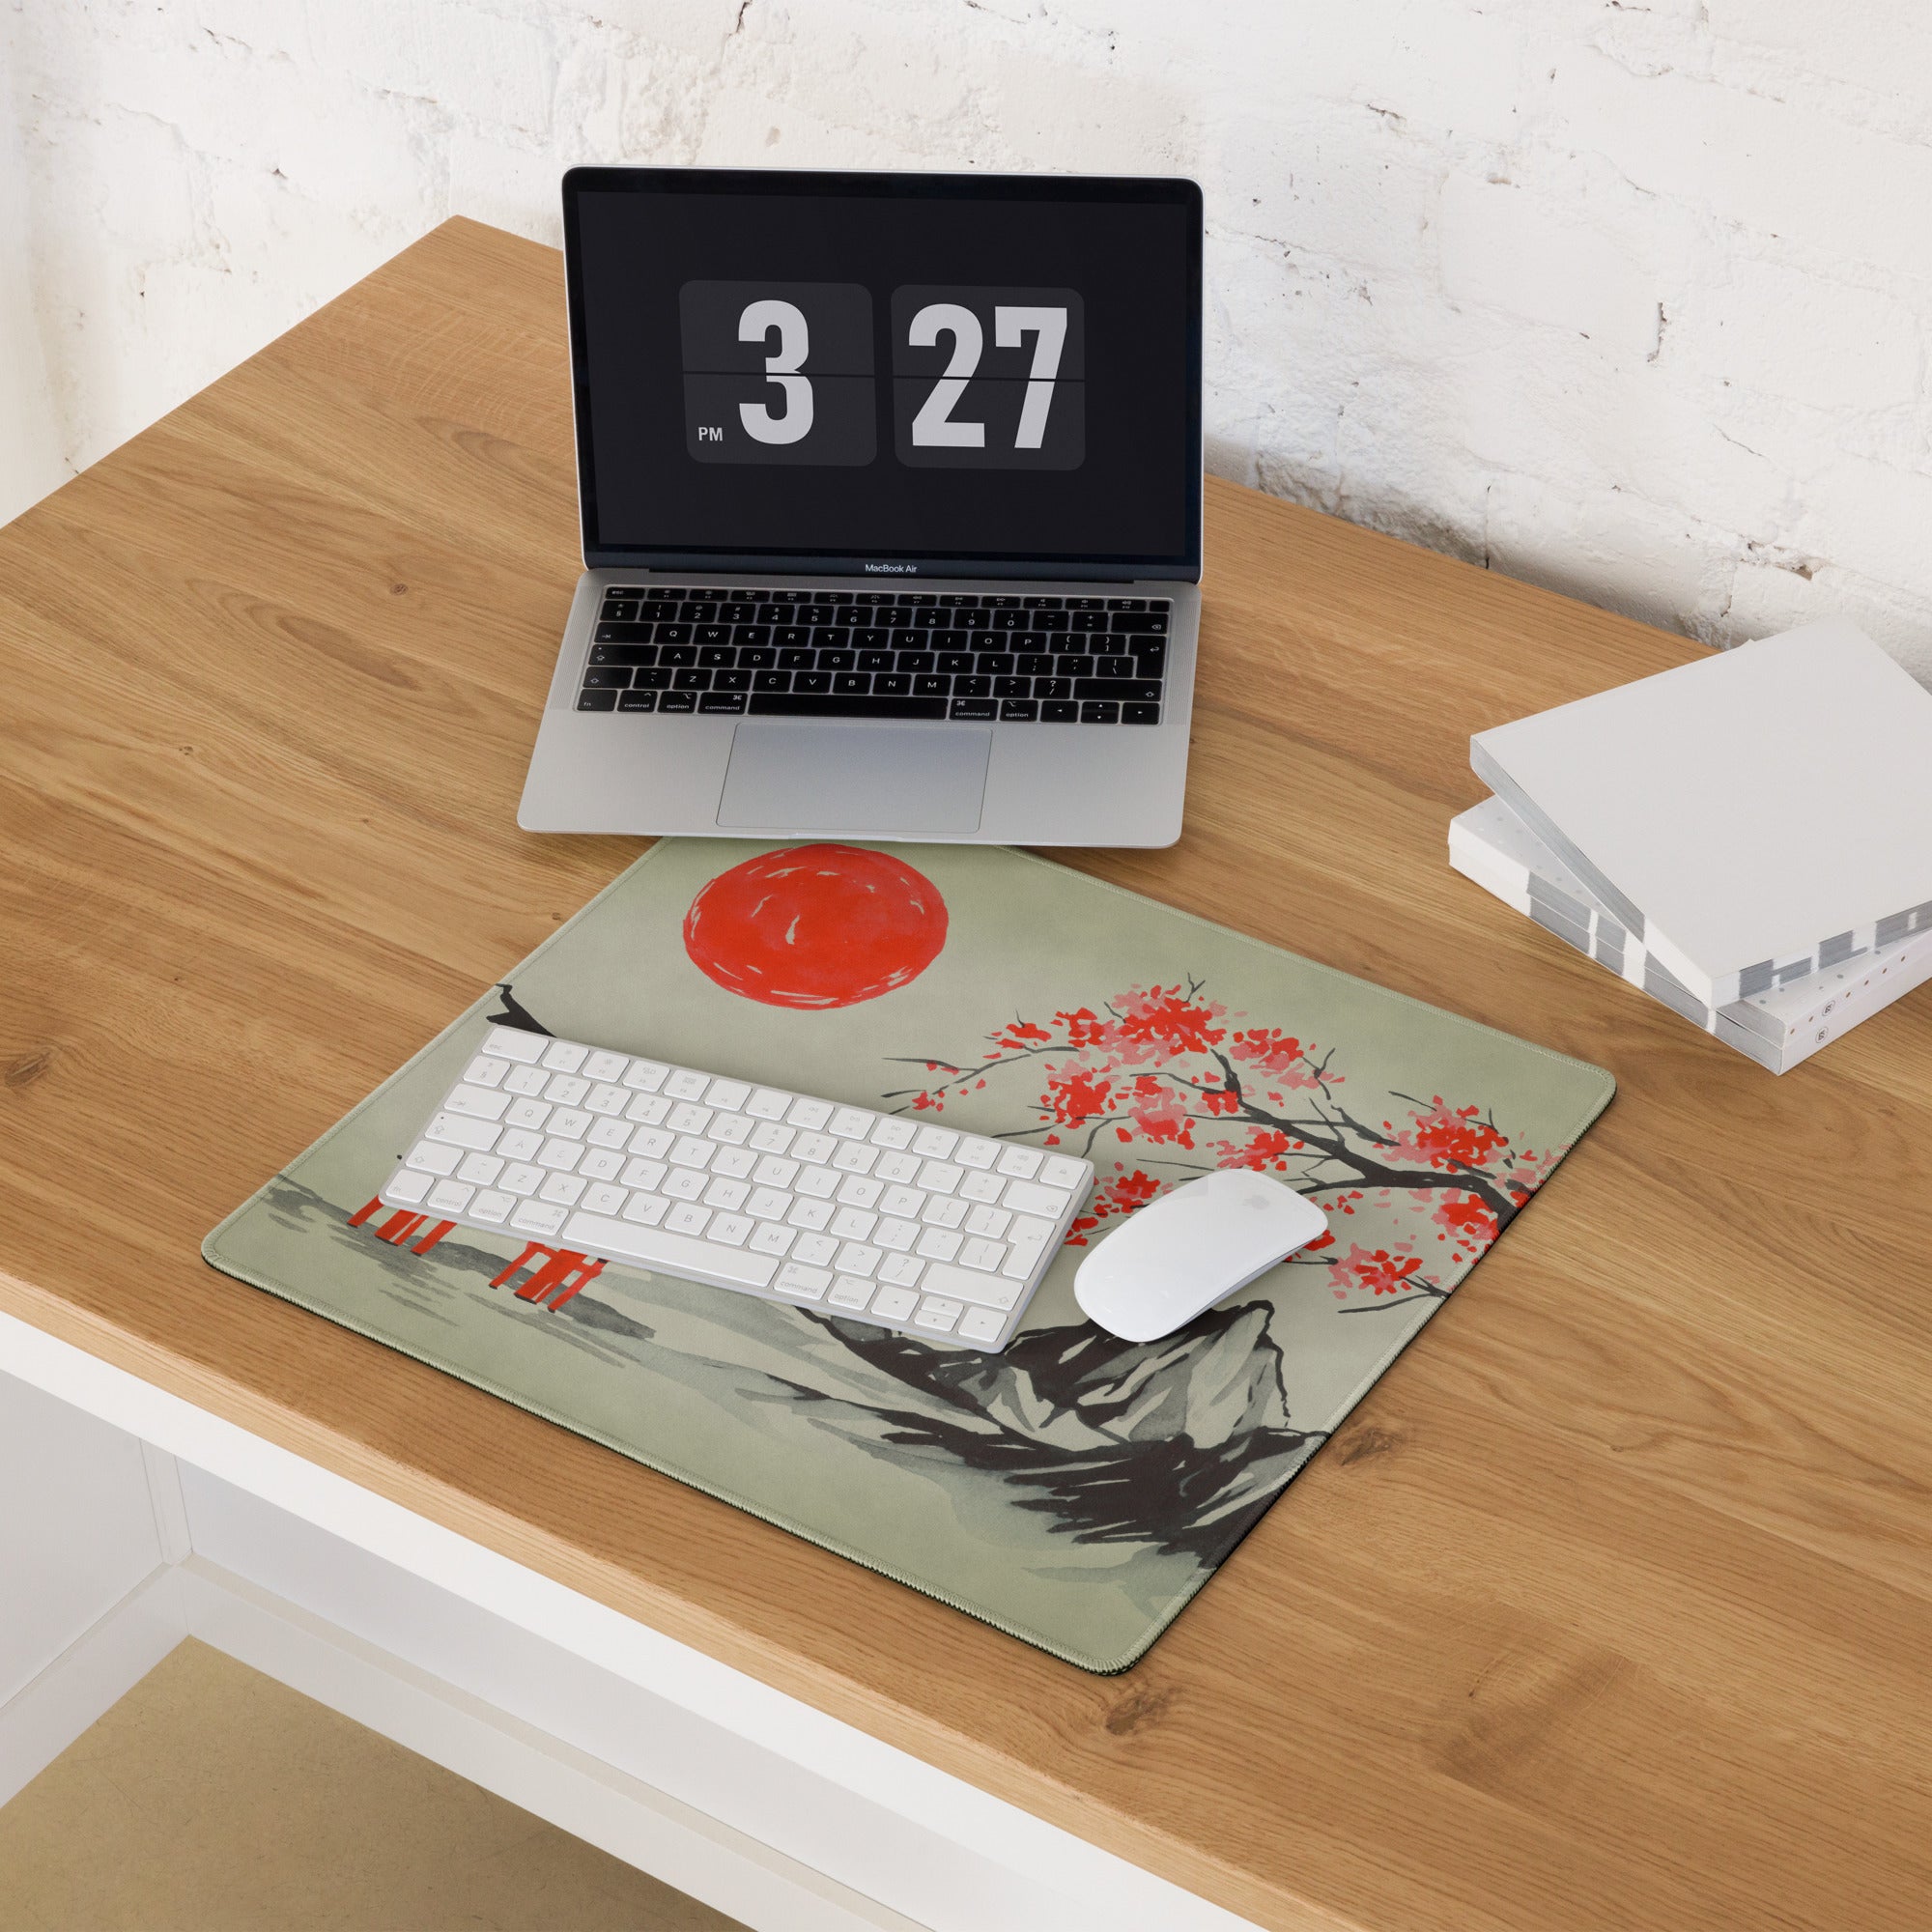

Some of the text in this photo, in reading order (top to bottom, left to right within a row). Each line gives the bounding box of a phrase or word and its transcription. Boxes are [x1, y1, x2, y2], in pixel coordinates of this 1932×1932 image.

[738, 299, 1067, 449] 3 27
[698, 426, 724, 441] PM
[865, 564, 918, 573] MacBook Air
[787, 632, 796, 640] R
[827, 633, 835, 641] T
[983, 637, 994, 645] O
[1023, 638, 1033, 646] P
[768, 676, 778, 685] C
[525, 1109, 534, 1118] Q
[772, 1167, 781, 1176] U
[856, 1187, 866, 1196] O
[597, 1159, 608, 1168] D
[681, 1179, 691, 1188] G
[850, 1219, 856, 1228] L
[436, 1197, 462, 1207] control
[478, 1208, 502, 1217] option
[558, 1183, 568, 1192] X
[768, 1234, 780, 1242] M
[518, 1218, 554, 1230] command
[780, 1281, 817, 1293] command
[834, 1293, 859, 1304] option
